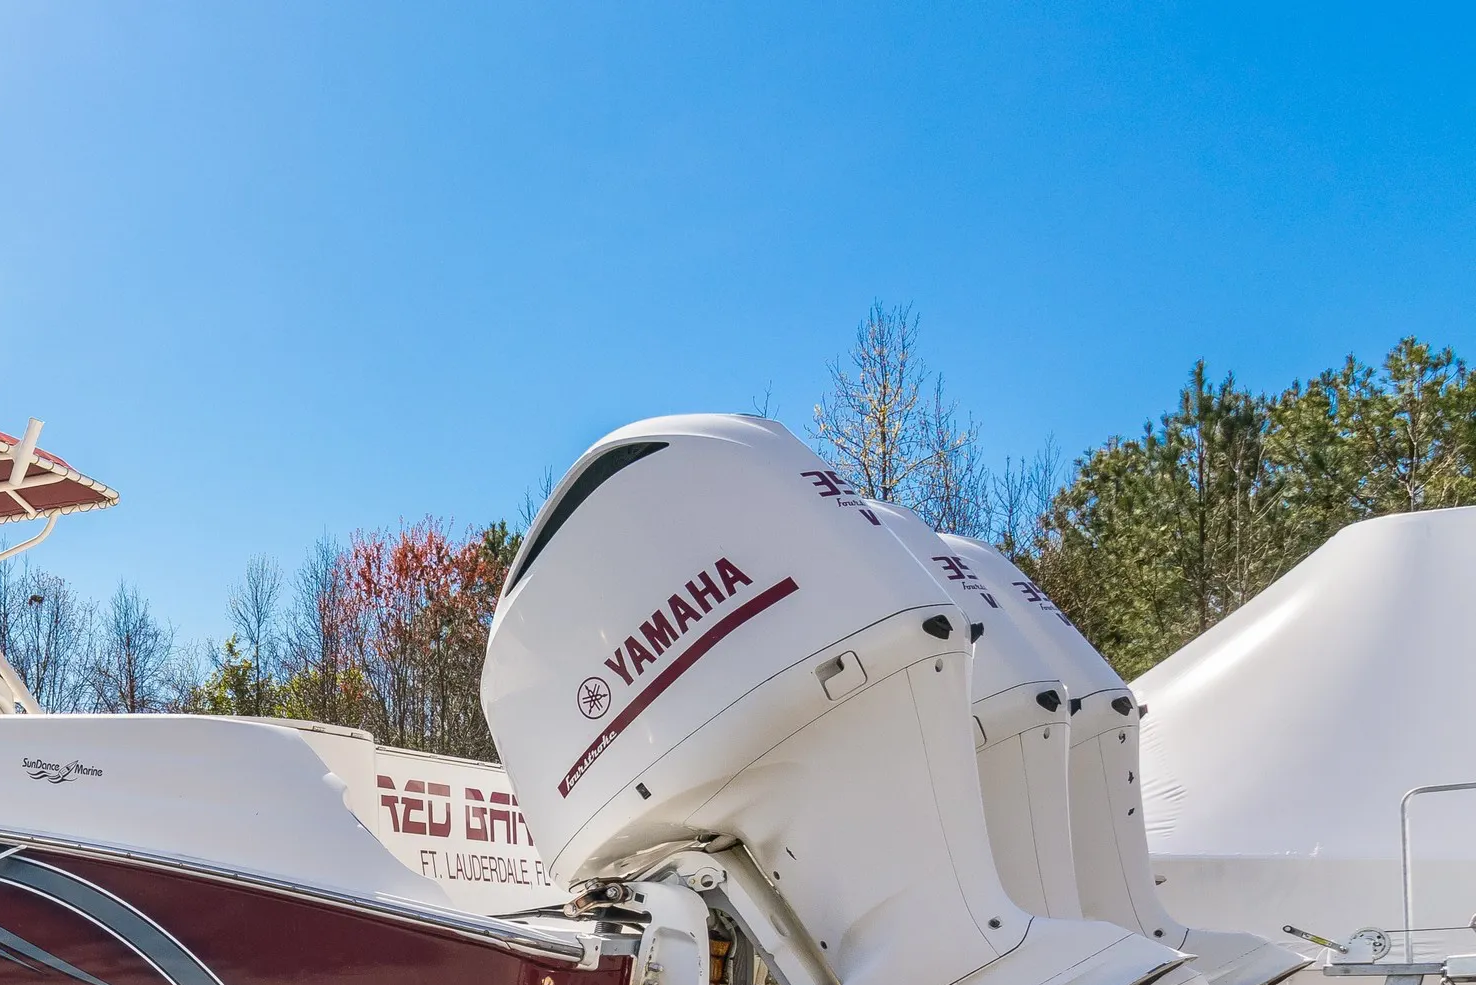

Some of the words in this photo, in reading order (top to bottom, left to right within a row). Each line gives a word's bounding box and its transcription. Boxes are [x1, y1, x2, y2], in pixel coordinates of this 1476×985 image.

[603, 556, 754, 687] YAMAHA
[21, 757, 61, 772] SunDance
[74, 764, 103, 778] Marine
[376, 774, 452, 838] RED
[420, 849, 443, 879] FT.
[445, 852, 534, 889] LAUDERDALE,
[534, 860, 551, 887] FL
